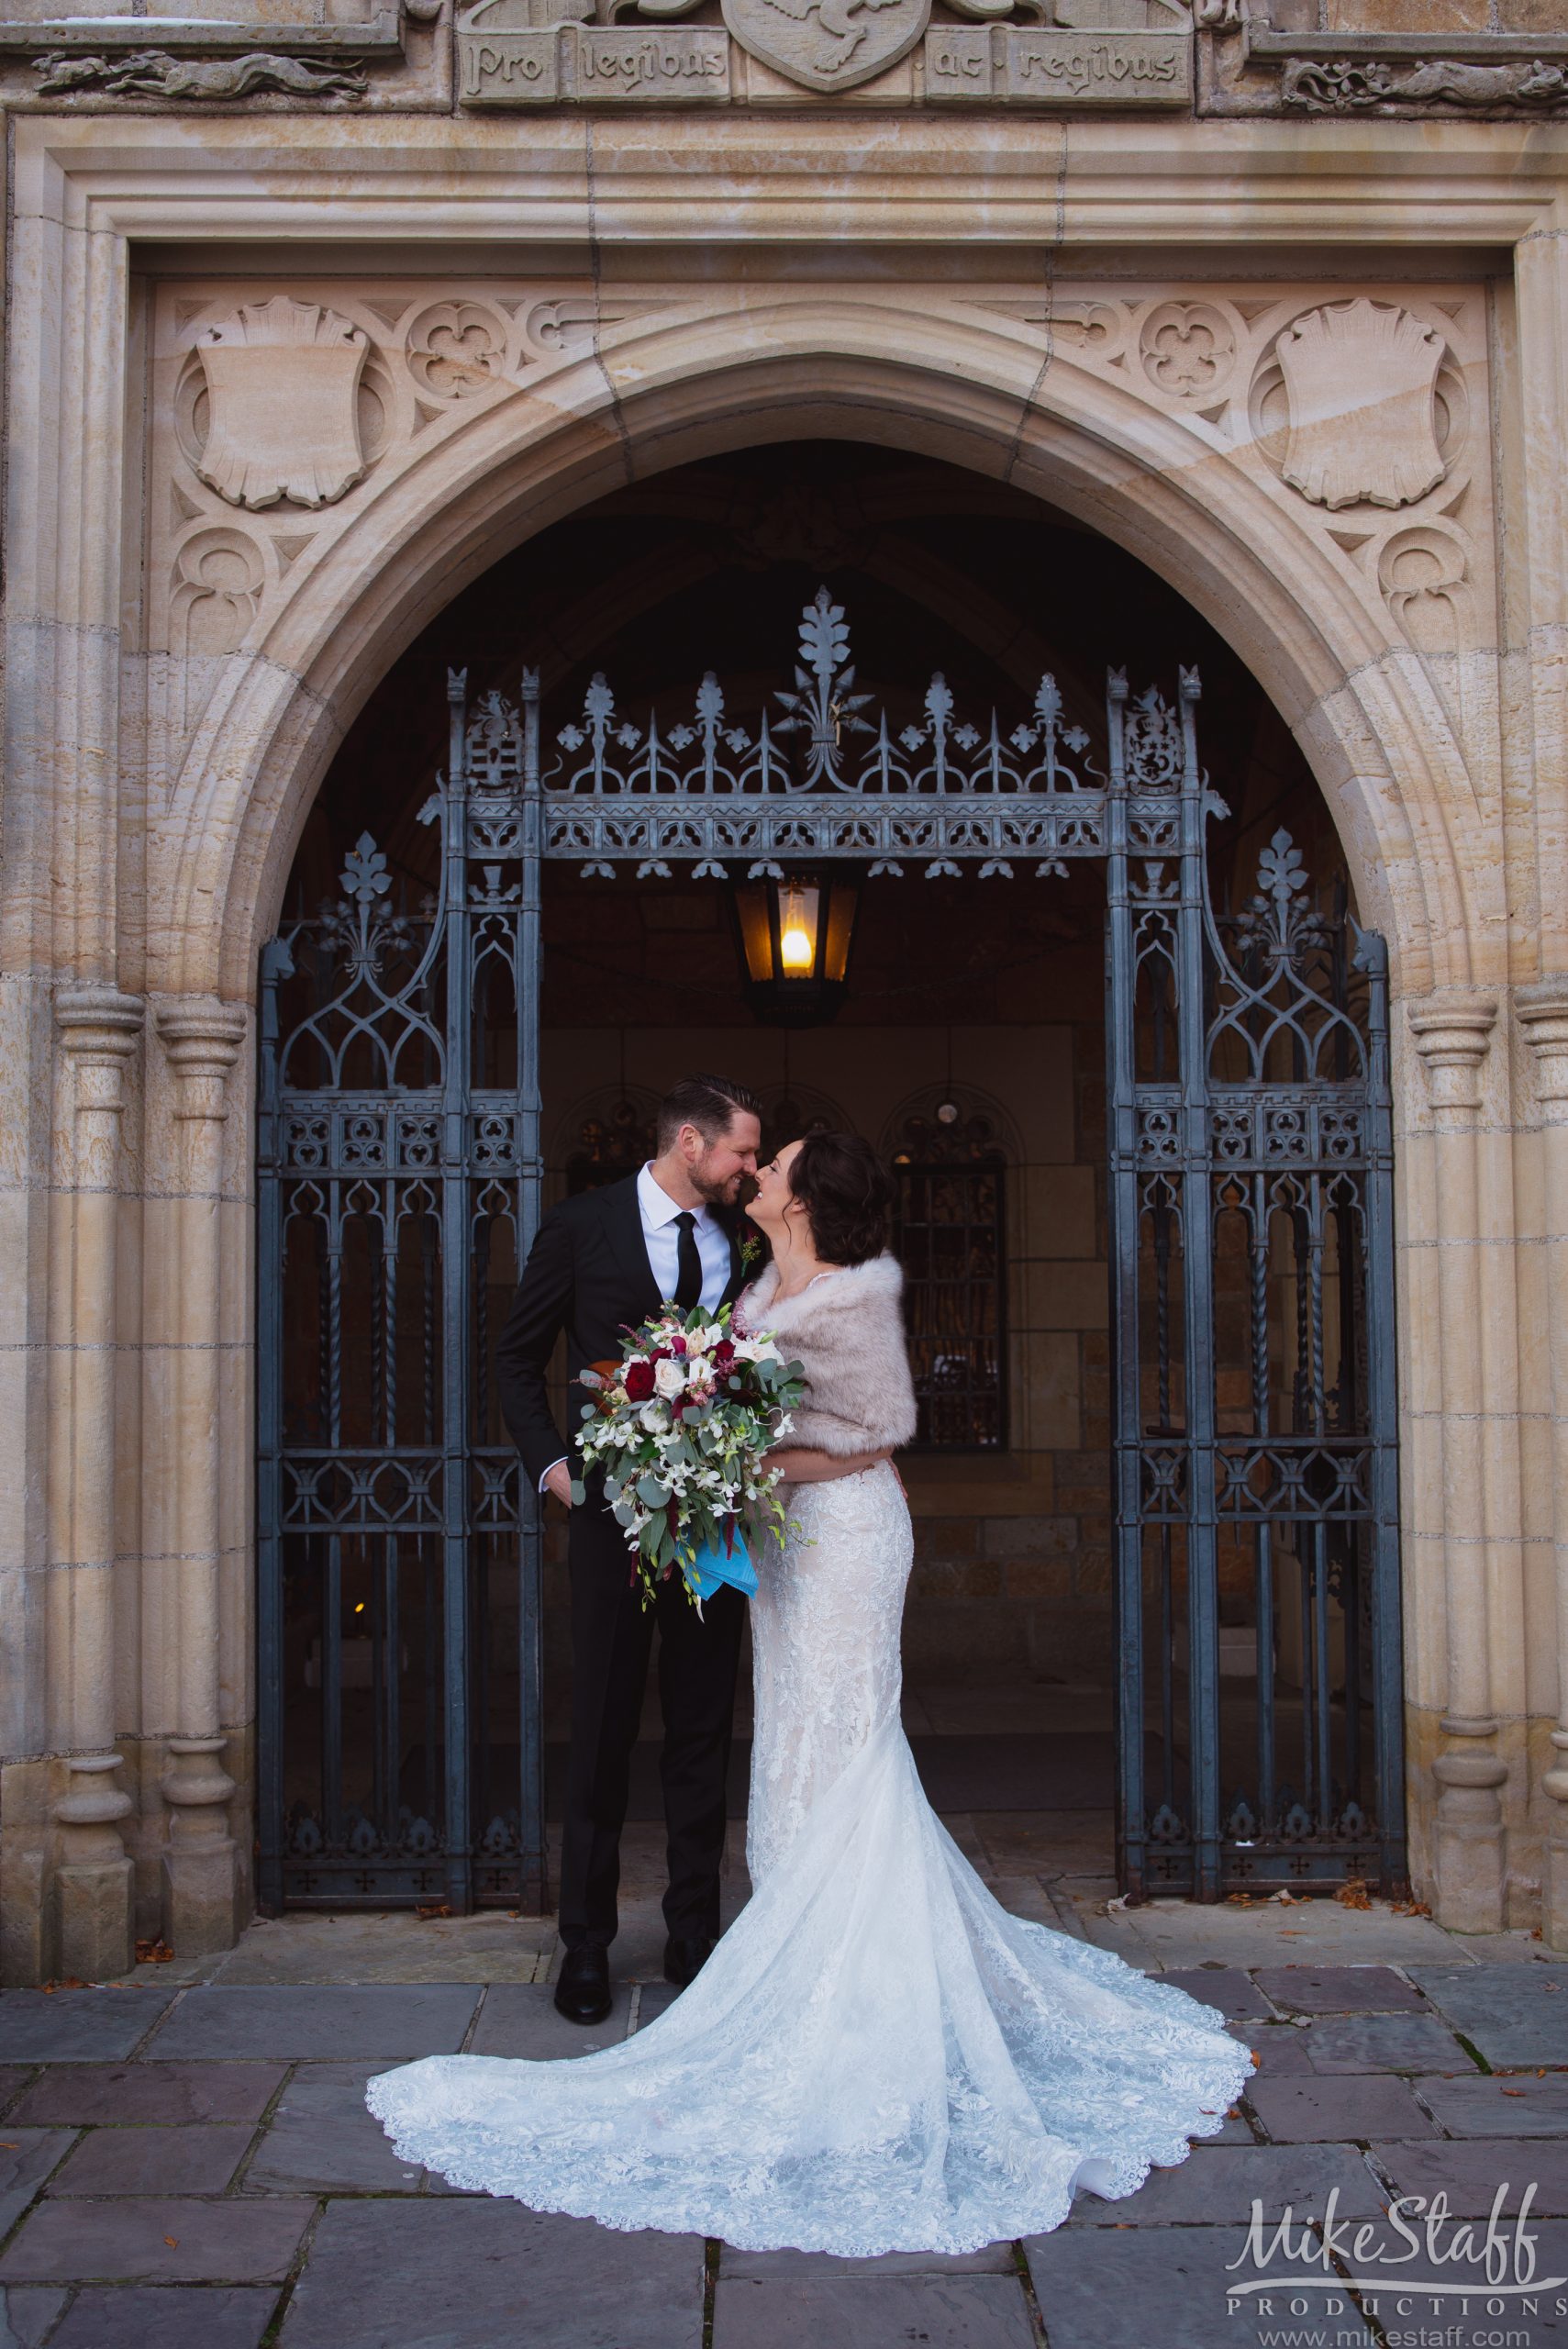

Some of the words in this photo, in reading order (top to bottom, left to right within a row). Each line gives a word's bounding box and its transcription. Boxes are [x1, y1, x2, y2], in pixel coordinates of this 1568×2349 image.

[466, 43, 543, 95] Pro
[582, 41, 726, 93] legibus
[934, 52, 984, 77] ac
[1019, 43, 1176, 95] regibus
